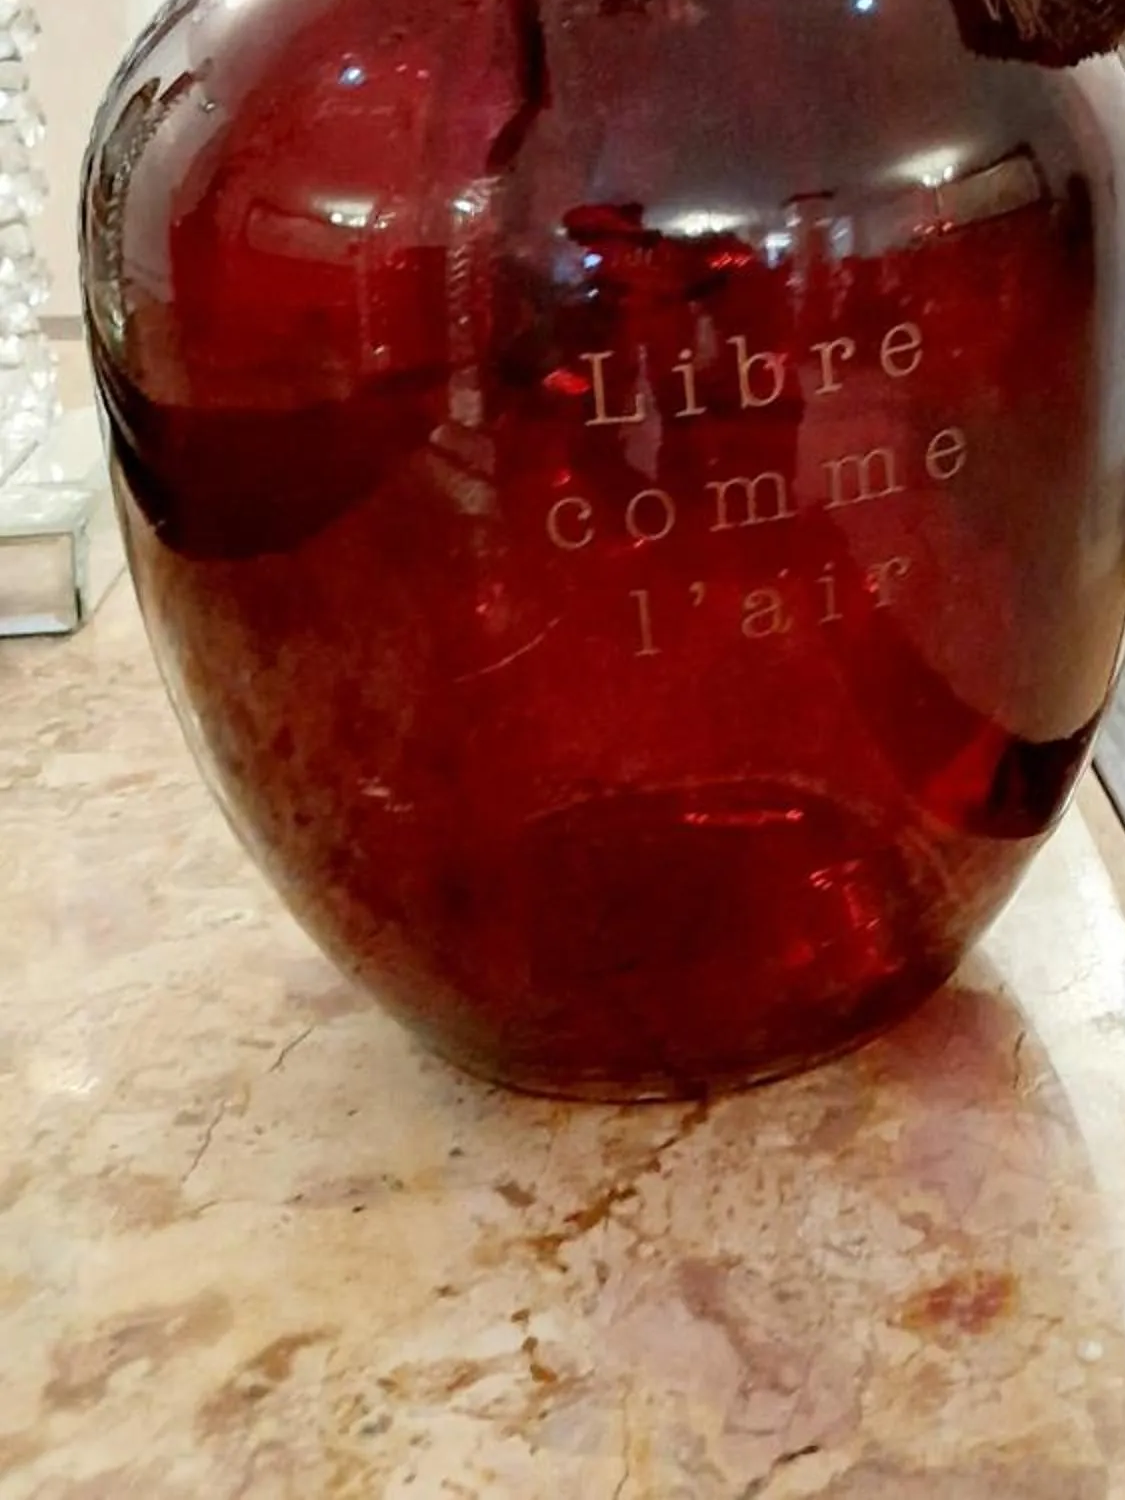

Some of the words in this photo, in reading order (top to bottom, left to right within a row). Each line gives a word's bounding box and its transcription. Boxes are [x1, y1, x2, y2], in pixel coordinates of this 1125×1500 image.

[579, 320, 923, 426] Libre
[547, 426, 966, 549] comme
[629, 555, 911, 656] l'air
